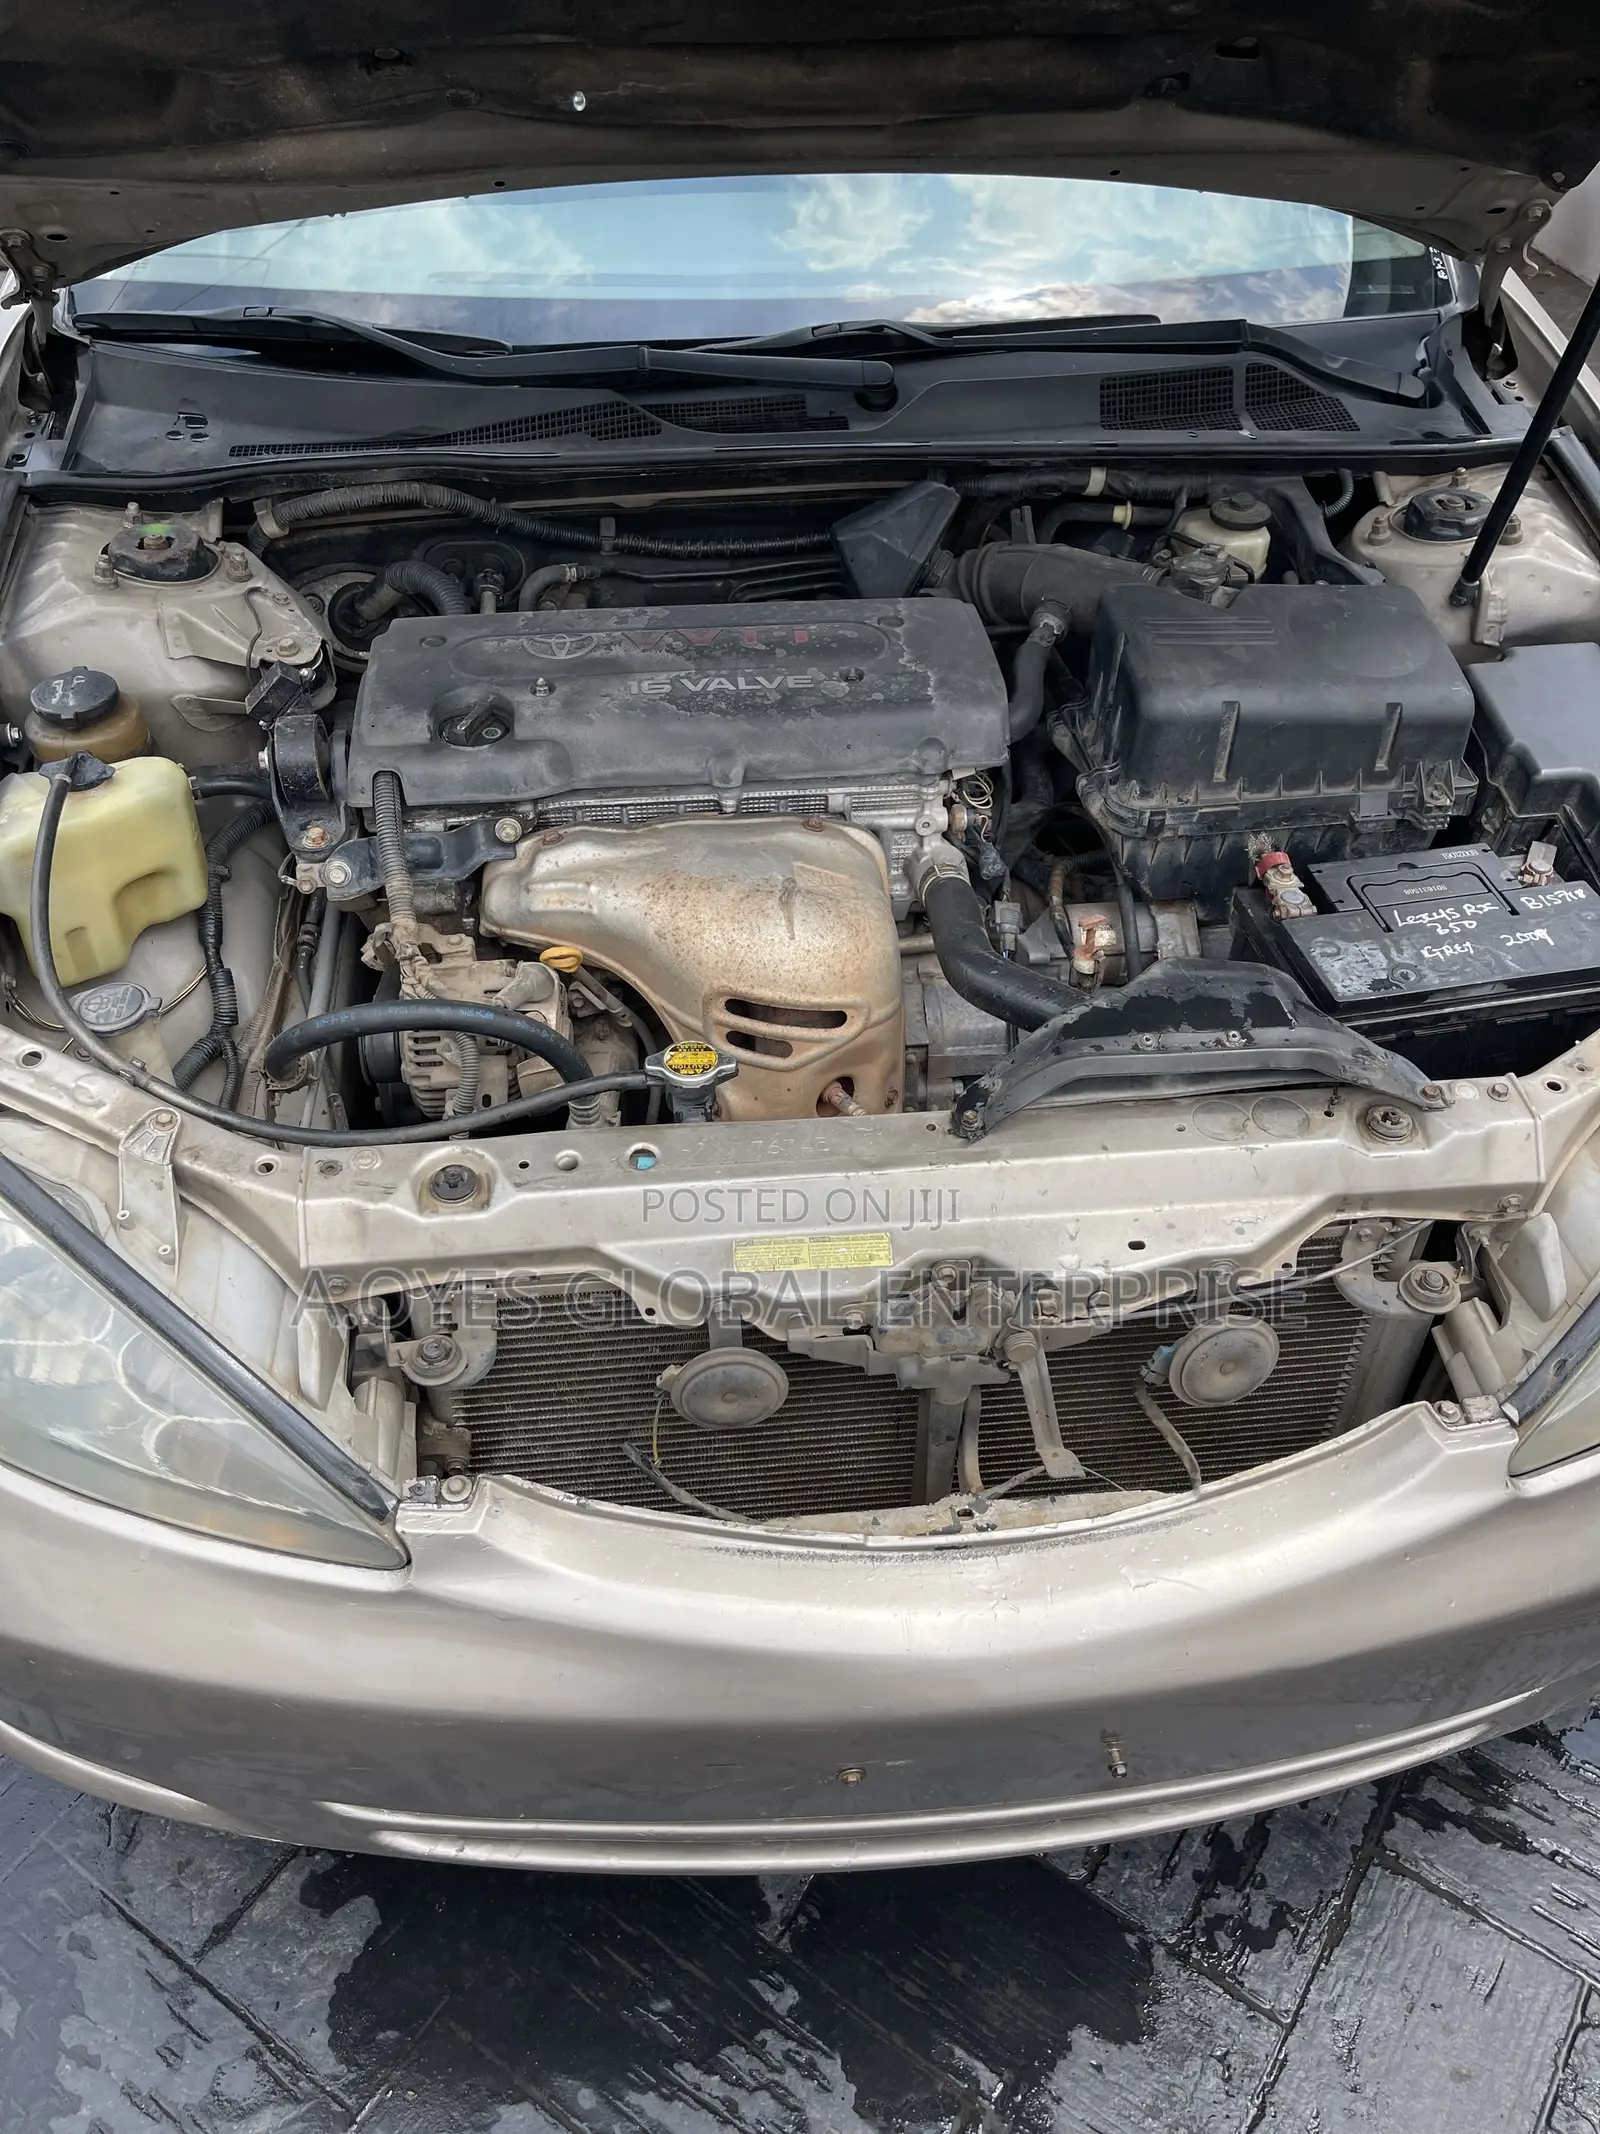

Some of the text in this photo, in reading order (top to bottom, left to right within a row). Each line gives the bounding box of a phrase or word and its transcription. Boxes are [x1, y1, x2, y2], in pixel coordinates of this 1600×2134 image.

[626, 675, 814, 695] 16 VALVE
[1426, 920, 1478, 935] 350
